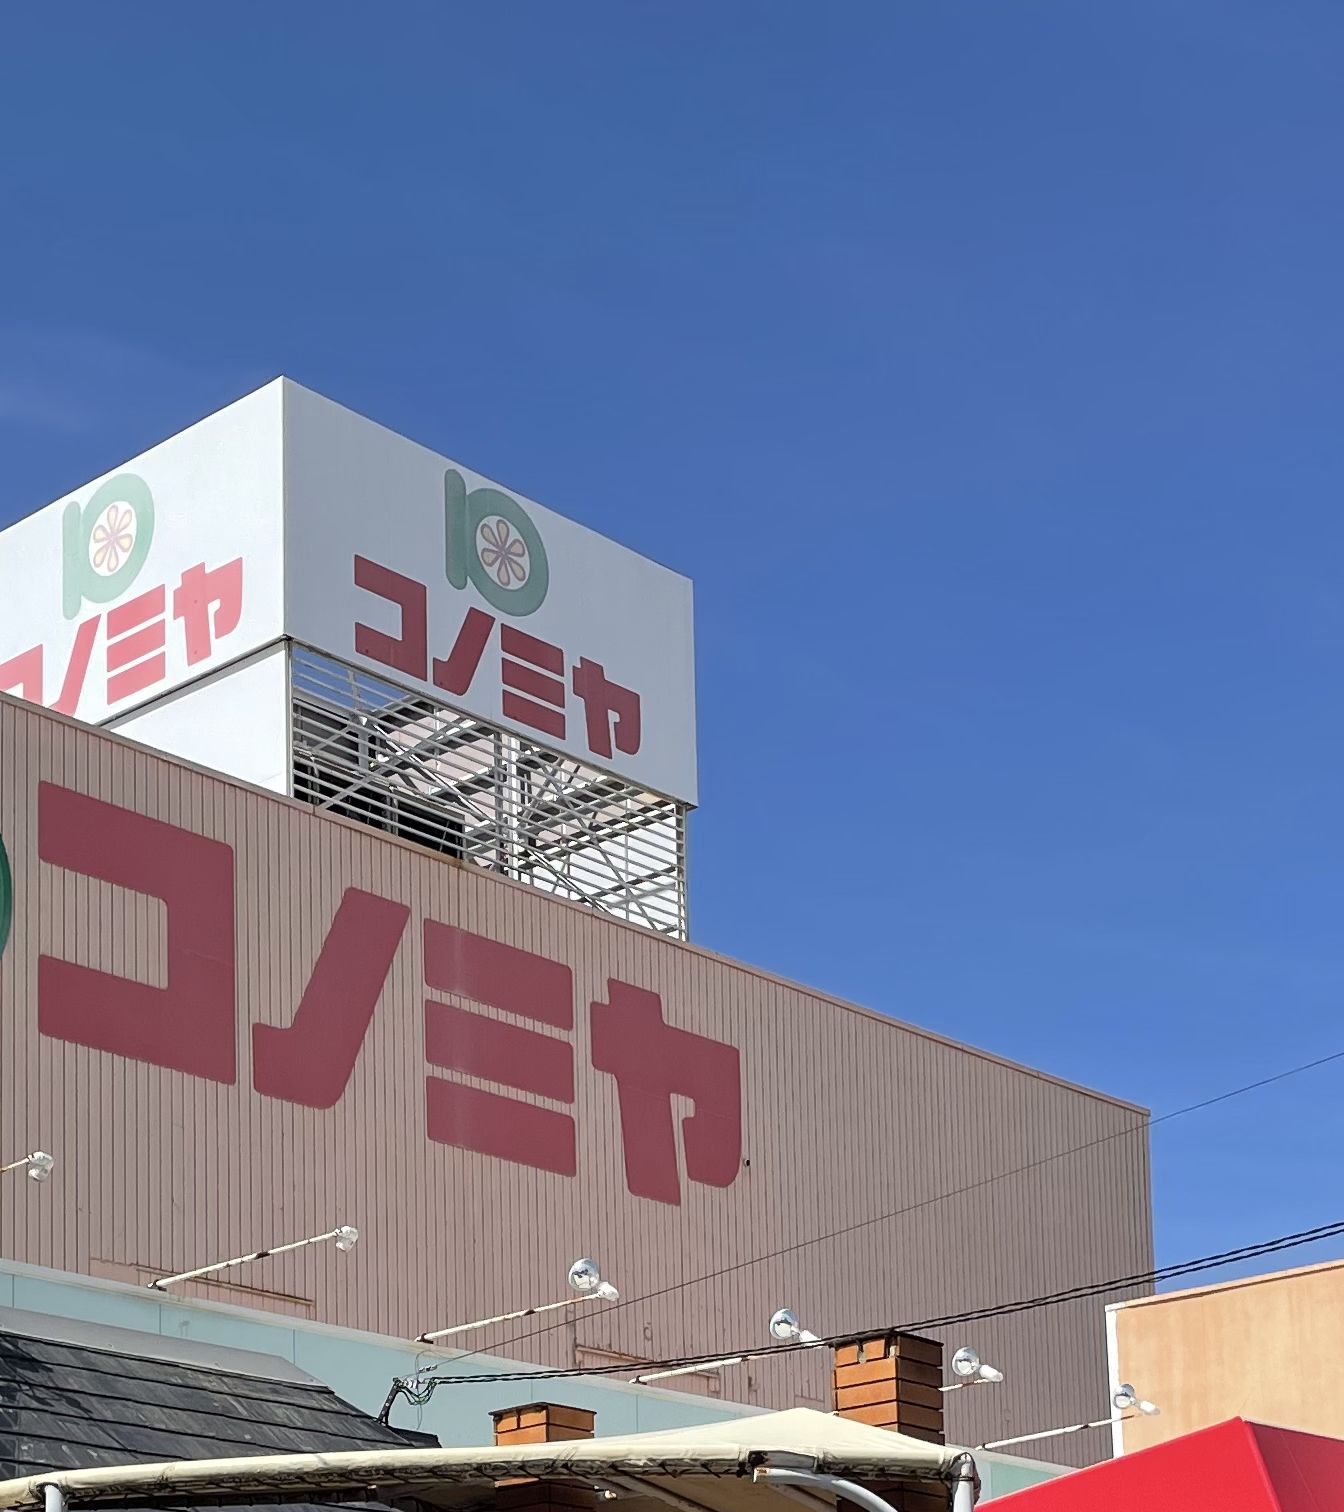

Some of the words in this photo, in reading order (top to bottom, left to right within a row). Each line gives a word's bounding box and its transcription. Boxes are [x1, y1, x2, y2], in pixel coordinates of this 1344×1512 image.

[353, 553, 642, 760] コノミヤ
[37, 779, 742, 1205] コノミヤ
